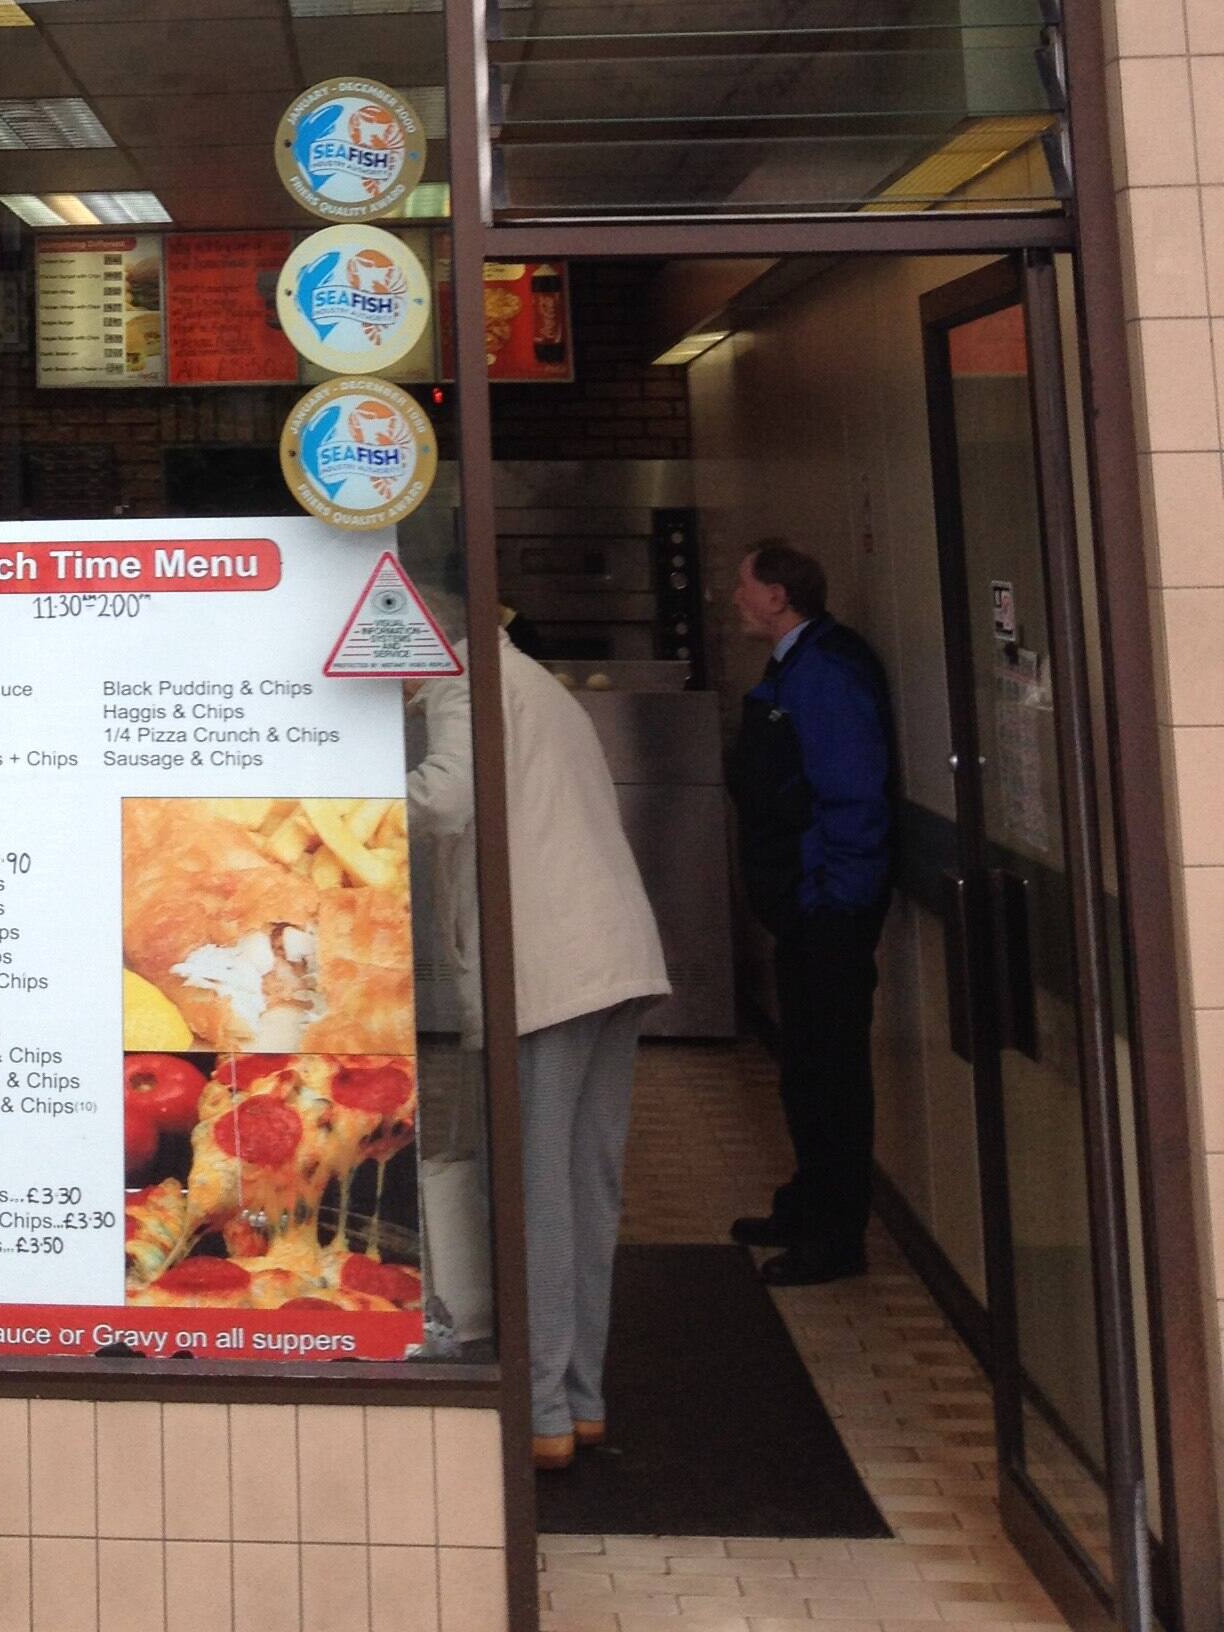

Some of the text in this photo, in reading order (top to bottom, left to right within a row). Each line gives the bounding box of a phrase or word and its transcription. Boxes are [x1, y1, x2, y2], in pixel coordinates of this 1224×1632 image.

[313, 143, 388, 168] SEAFISH
[316, 290, 393, 313] SEAFISH
[321, 446, 400, 465] SEAFISH
[49, 550, 142, 579] Time
[153, 548, 259, 578] Menu
[104, 680, 313, 699] Black Pudding & Chips
[104, 704, 245, 723] Haggis & Chips
[104, 727, 340, 746] 1/4 Pizza Crunch & Chips
[9, 753, 21, 764] +
[27, 751, 78, 770] Chips
[104, 750, 264, 770] Sausage & Chips
[9, 1047, 62, 1068] Chips
[7, 1072, 20, 1088] &
[27, 1072, 80, 1093] Chips
[0, 1097, 14, 1113] &
[59, 1327, 85, 1345] or
[93, 1325, 167, 1351] Gravy
[176, 1330, 207, 1347] on
[216, 1328, 244, 1348] all
[253, 1333, 356, 1354] suppers
